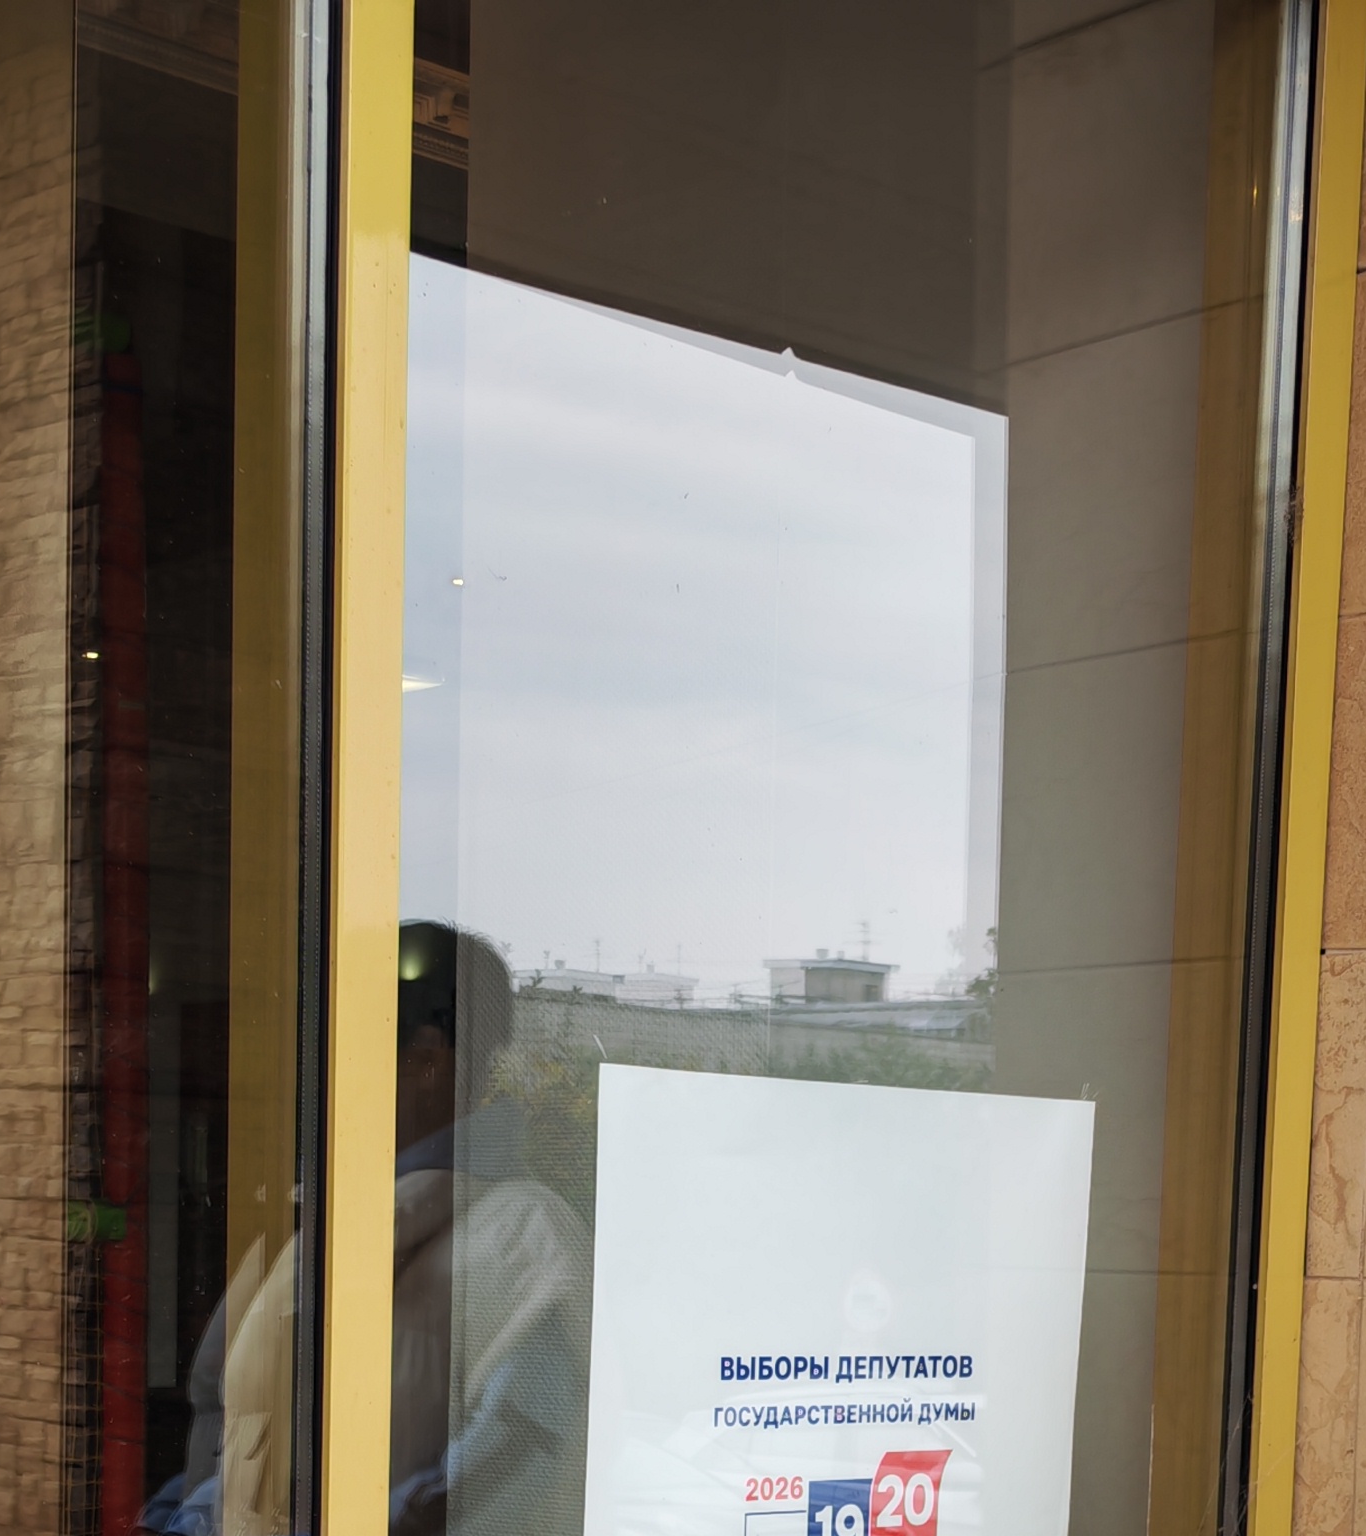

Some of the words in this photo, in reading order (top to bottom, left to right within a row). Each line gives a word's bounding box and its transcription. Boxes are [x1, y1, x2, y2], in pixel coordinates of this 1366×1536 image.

[720, 1355, 830, 1381] ВЫБОРЫ
[835, 1355, 974, 1383] ДЕПУТАТОВ
[713, 1398, 913, 1429] ГОСУДАРСТВЕННОЙ
[917, 1402, 976, 1426] ДУМЫ
[745, 1476, 804, 1502] 2026
[876, 1473, 935, 1528] 20
